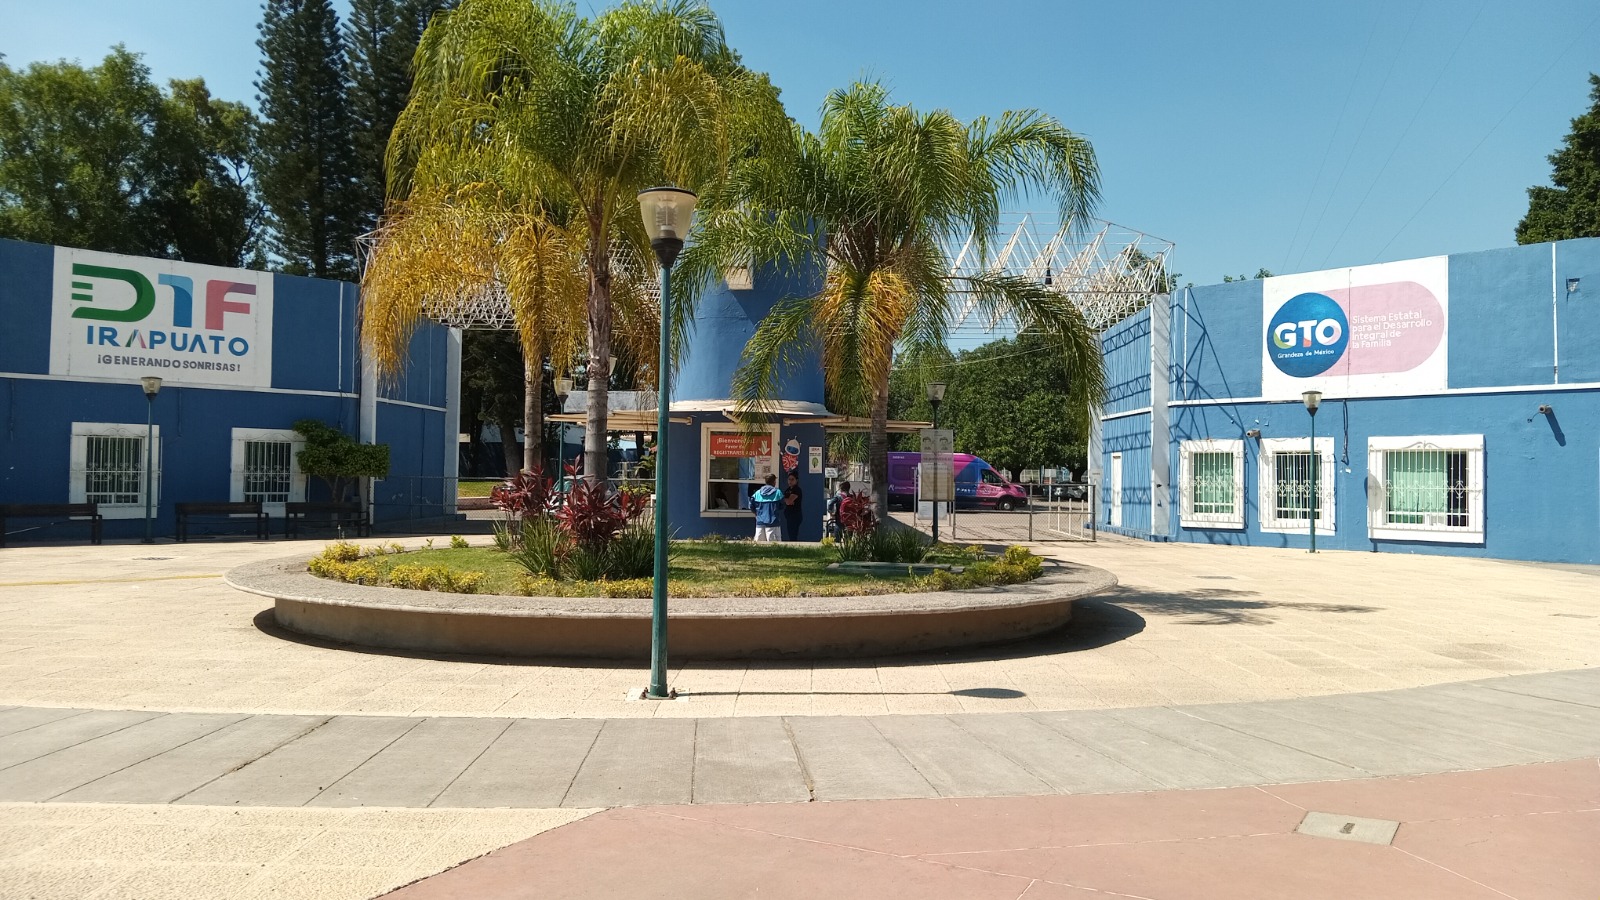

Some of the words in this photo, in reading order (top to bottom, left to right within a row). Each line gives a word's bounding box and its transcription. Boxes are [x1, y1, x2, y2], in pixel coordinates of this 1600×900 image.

[71, 263, 257, 331] DIF
[1352, 315, 1387, 324] Sistema
[1388, 310, 1422, 321] Estatal
[1273, 318, 1342, 349] GTO
[1352, 325, 1372, 334] para
[1373, 322, 1381, 331] el
[1383, 319, 1433, 330] Desarrollo
[87, 325, 249, 357] IRAPUATO
[1352, 330, 1389, 341] Integral
[1389, 330, 1402, 338] de
[1352, 341, 1360, 349] la
[1361, 339, 1392, 348] Familia
[1277, 351, 1304, 359] Grandeza
[1313, 348, 1335, 356] México
[97, 354, 181, 369] ¡GENERANDO
[182, 360, 241, 372] SONRISAS!
